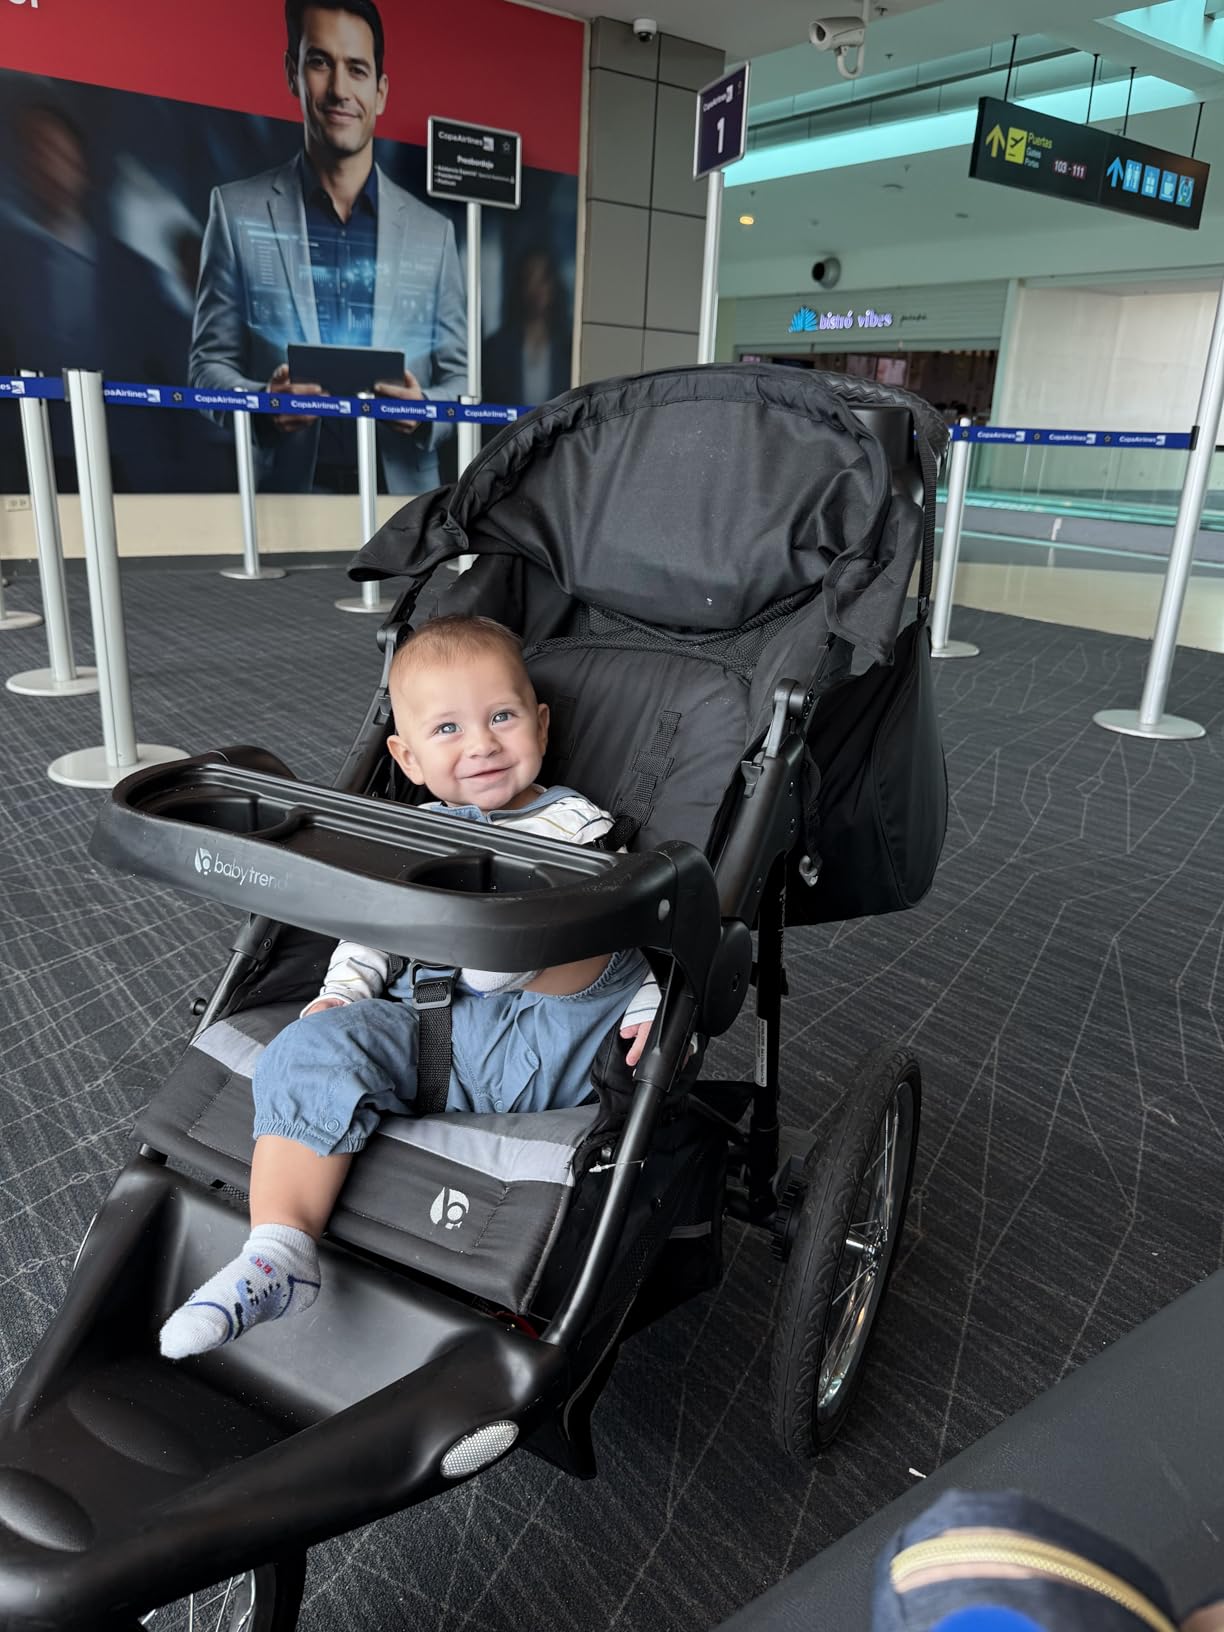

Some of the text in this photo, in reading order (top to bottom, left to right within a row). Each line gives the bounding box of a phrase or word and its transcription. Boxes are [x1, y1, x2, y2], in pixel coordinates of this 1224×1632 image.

[716, 117, 725, 154] 1
[1028, 132, 1053, 149] Puertas
[1054, 160, 1068, 174] 103
[1072, 164, 1085, 178] 111
[819, 310, 854, 330] bistró
[857, 309, 893, 328] vibes
[104, 389, 147, 400] paAirlines
